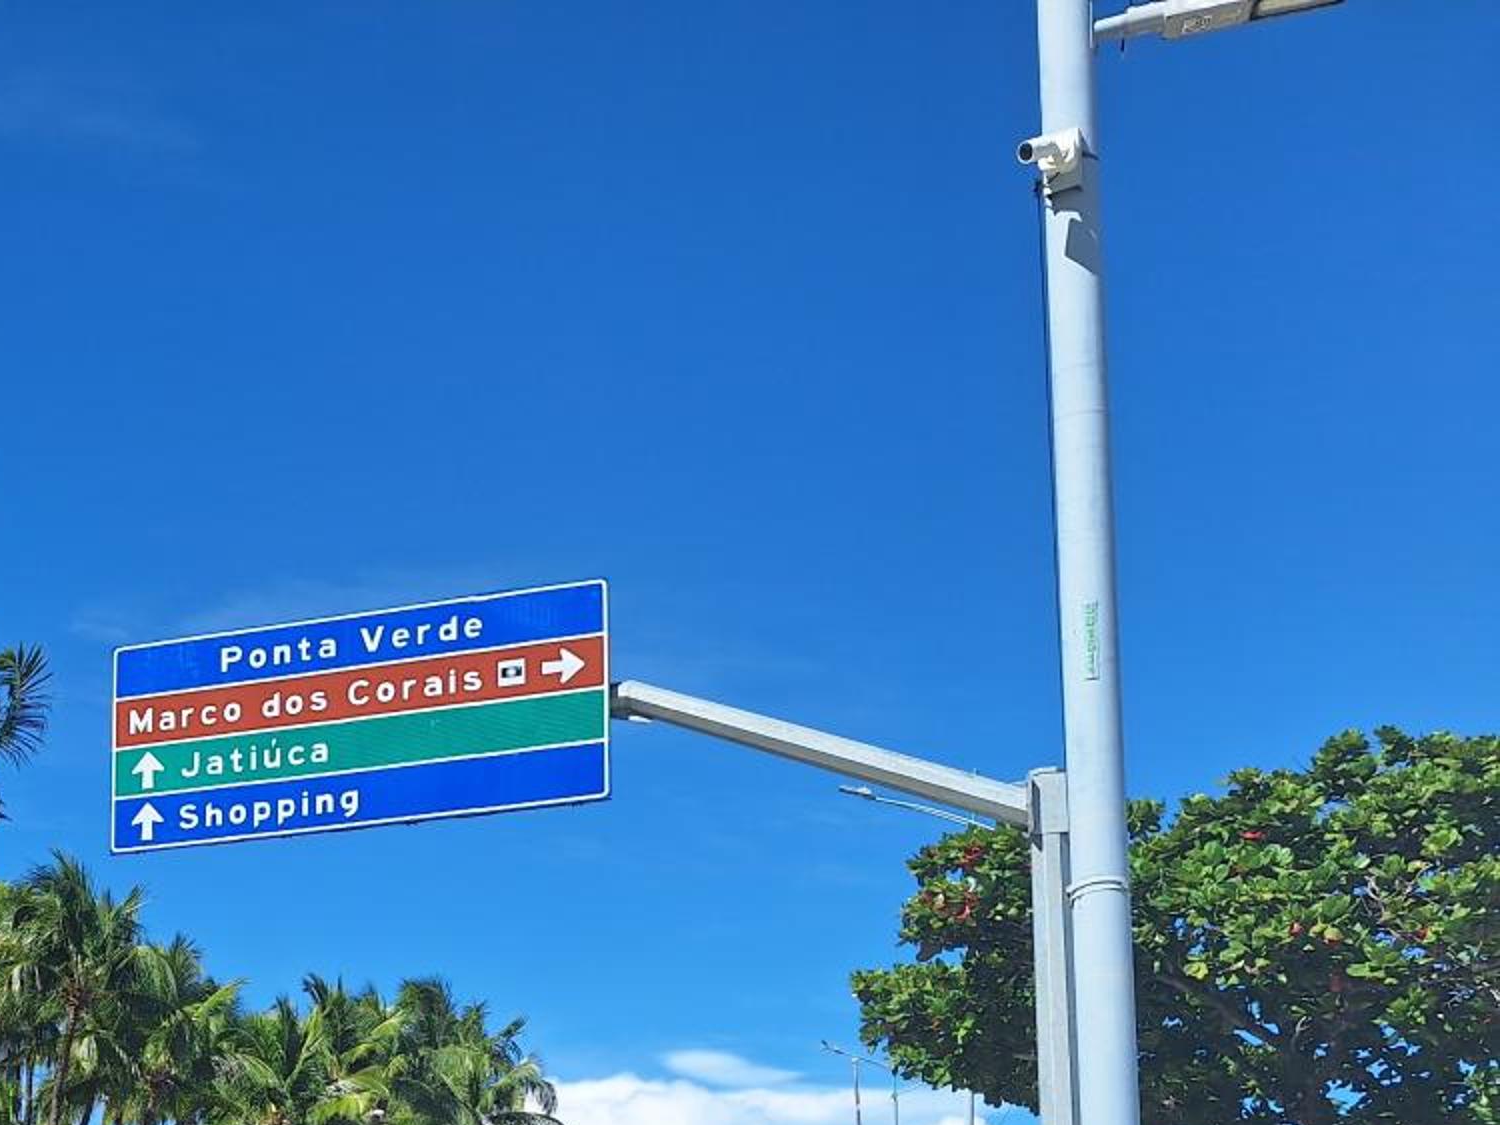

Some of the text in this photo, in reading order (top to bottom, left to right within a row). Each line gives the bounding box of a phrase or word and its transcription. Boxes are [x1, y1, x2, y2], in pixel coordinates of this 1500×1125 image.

[220, 615, 484, 673] Ponta Verde
[129, 668, 482, 735] Marco dos Corais
[181, 740, 329, 779] Jatiúca
[179, 790, 360, 830] Shopping
